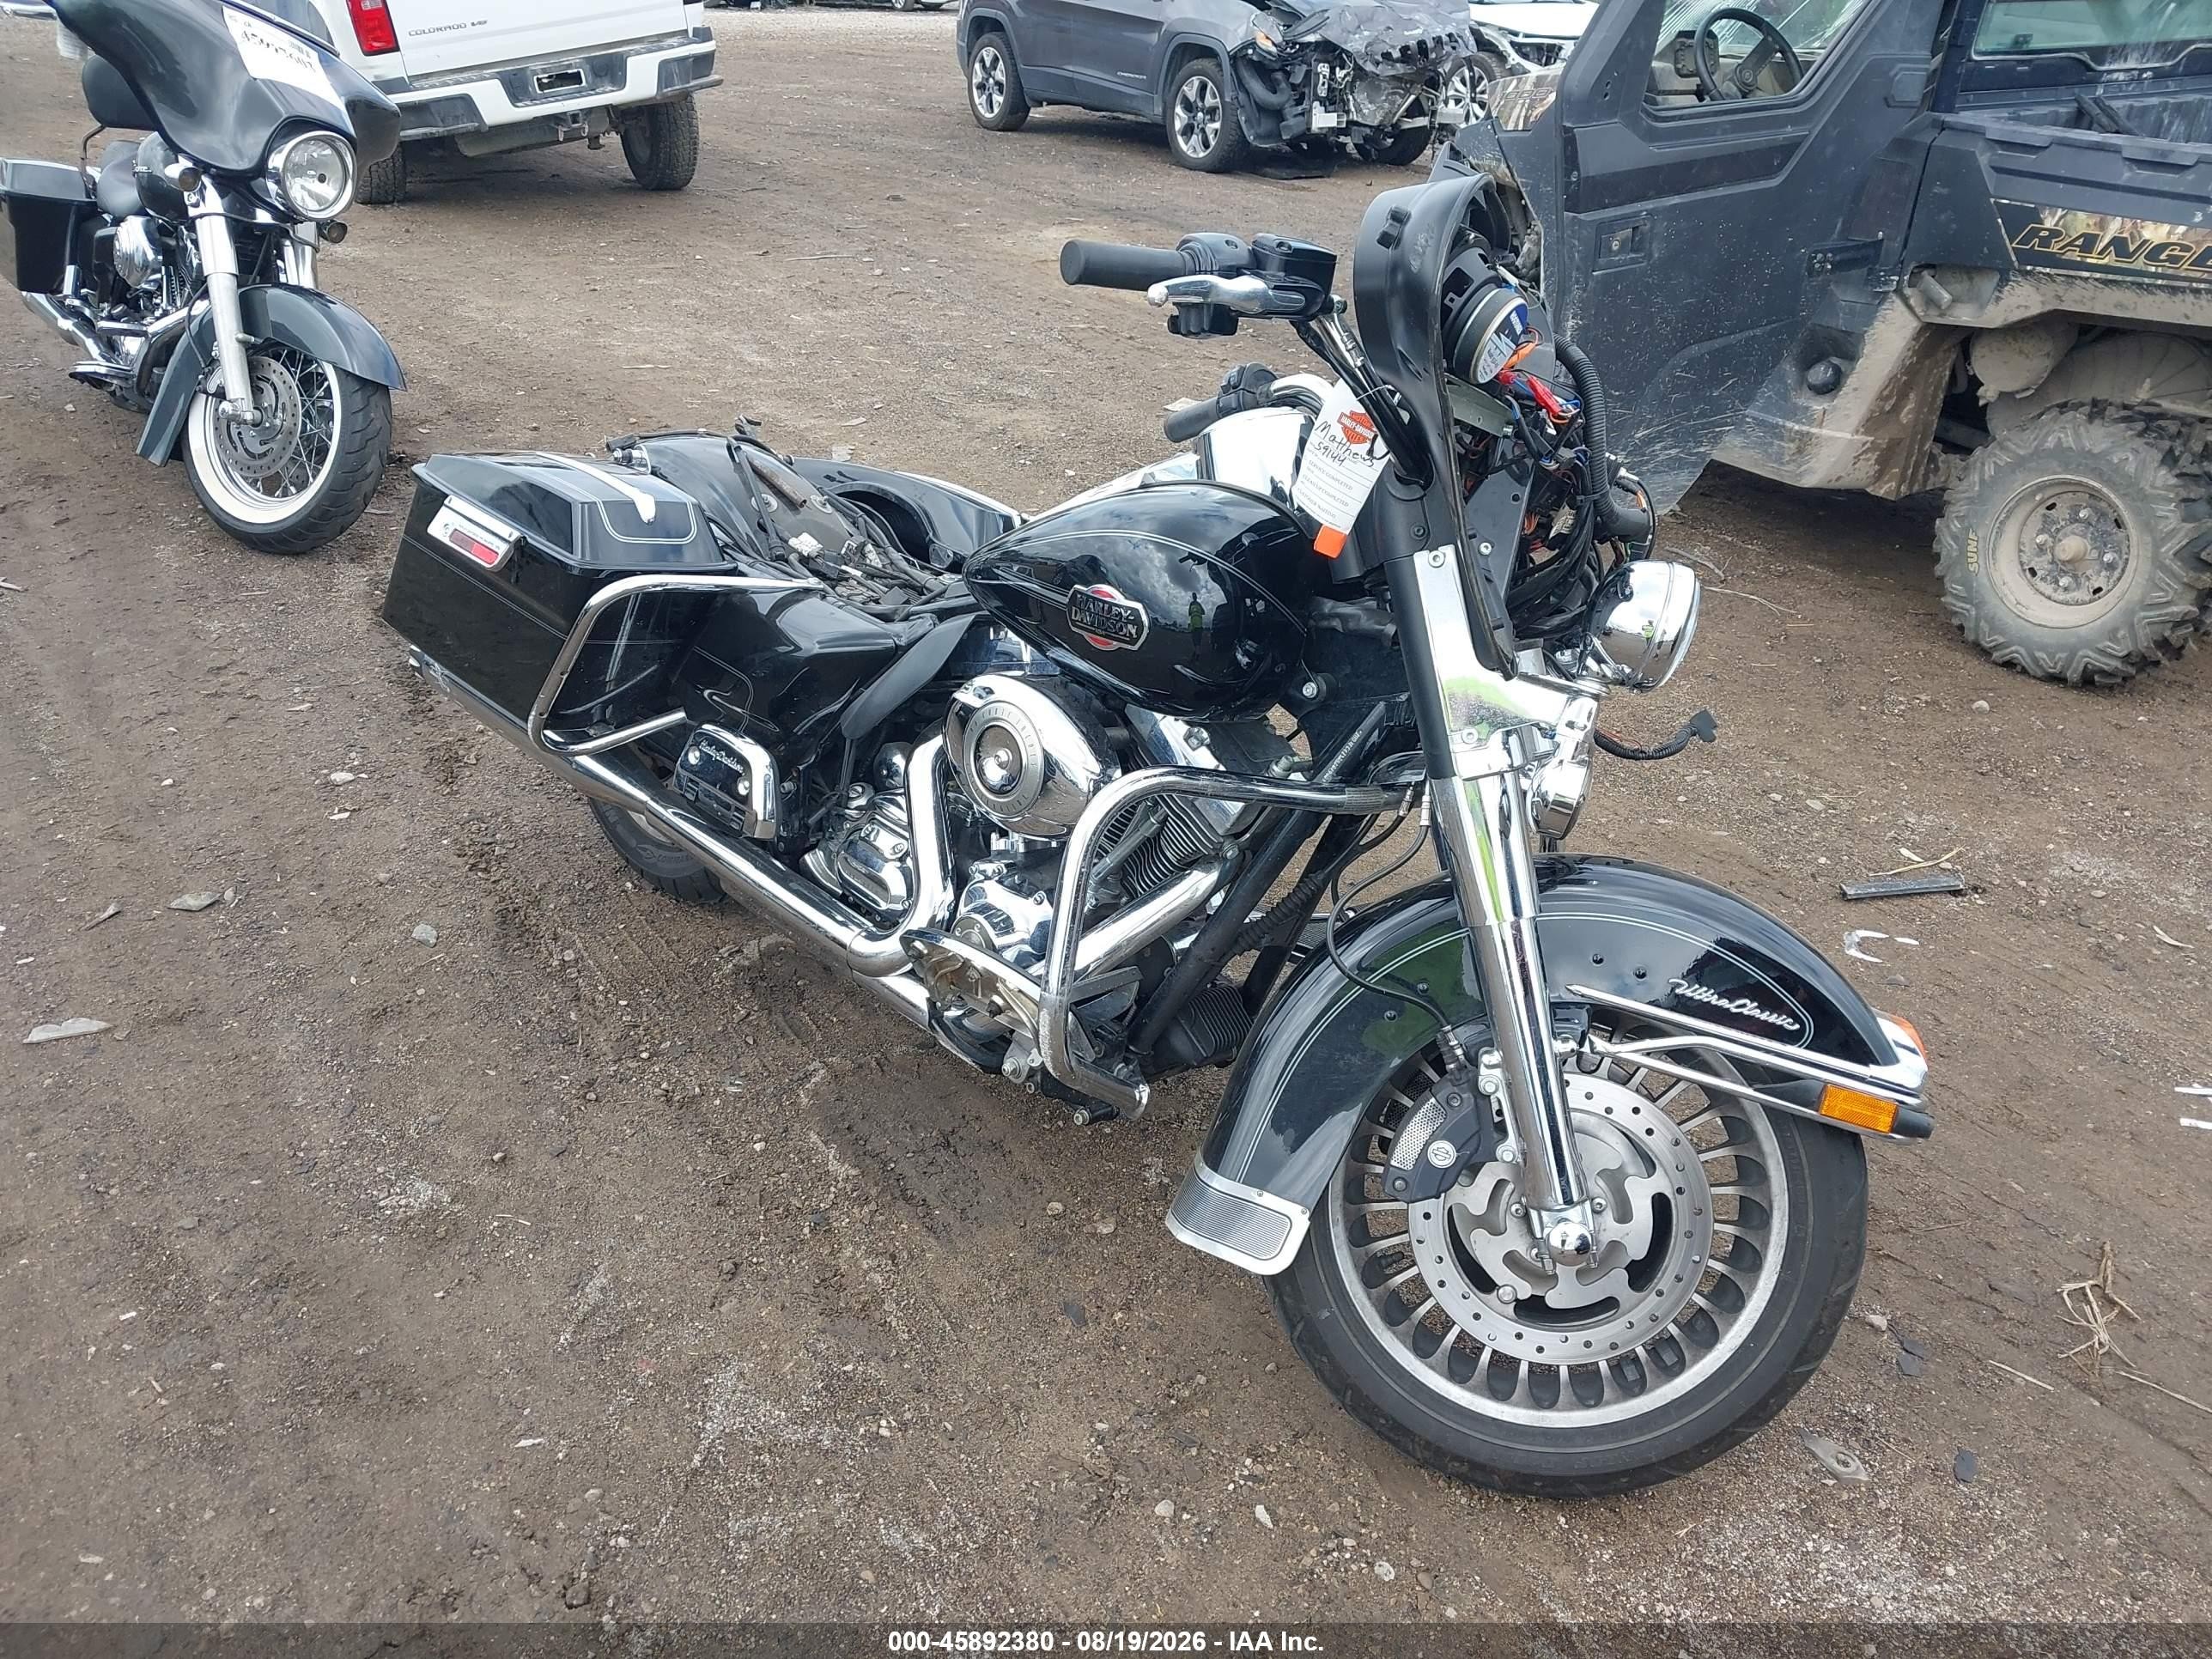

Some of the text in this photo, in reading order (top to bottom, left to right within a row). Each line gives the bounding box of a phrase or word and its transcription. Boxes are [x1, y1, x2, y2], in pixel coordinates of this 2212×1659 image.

[408, 22, 467, 37] COLORADO
[1071, 605, 1139, 639] DAVIDSON
[1076, 594, 1135, 623] HARLEY-
[1668, 978, 1801, 1030] Ultra Classic
